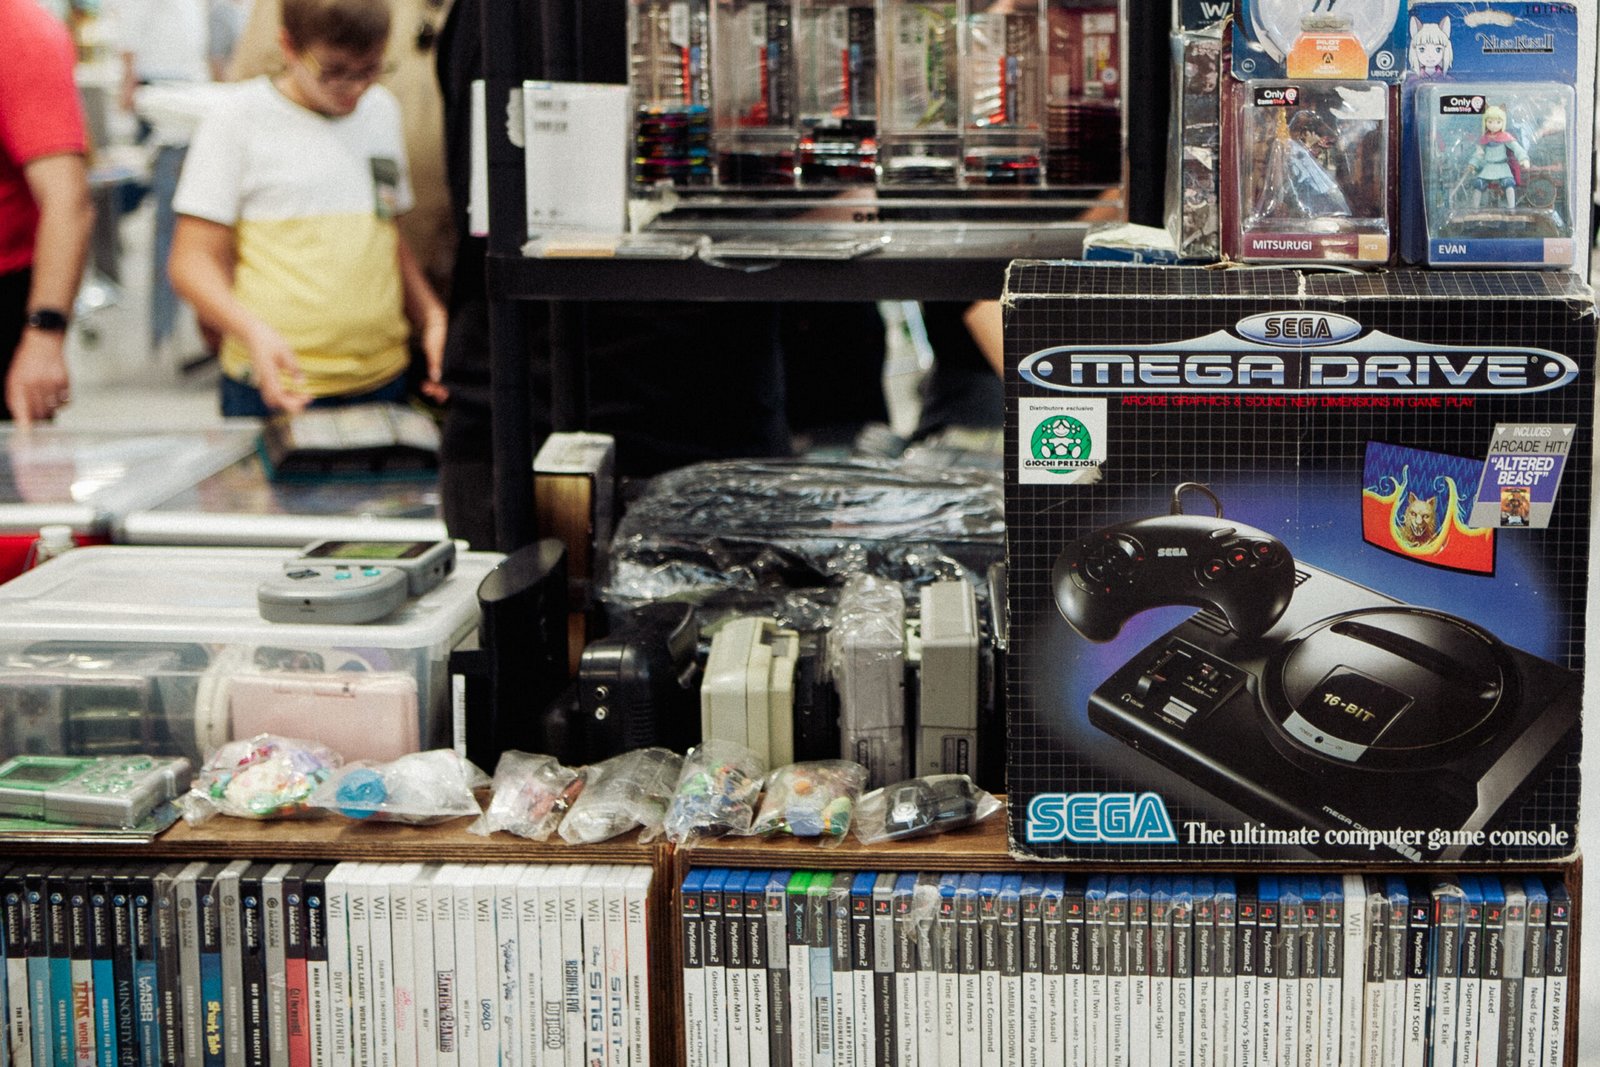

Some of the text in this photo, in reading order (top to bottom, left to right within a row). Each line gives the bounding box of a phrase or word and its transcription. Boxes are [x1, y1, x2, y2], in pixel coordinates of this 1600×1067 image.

[1252, 238, 1313, 251] MITSURUGI
[1438, 243, 1467, 255] EVAN
[1264, 317, 1332, 339] SEGA
[1070, 354, 1284, 385] MEGA
[1122, 395, 1168, 407] ARCADE
[1172, 395, 1231, 407] GRAPHICS
[1233, 396, 1241, 407] &
[1291, 396, 1318, 408] NEW
[1321, 397, 1390, 408] DIMENSIONS
[1392, 398, 1404, 408] IN
[1408, 398, 1442, 408] GAME
[1446, 398, 1475, 408] PLAY
[1513, 427, 1552, 437] INCLUDES
[1491, 440, 1568, 453] ARCADE HIT!
[1157, 547, 1188, 557] SEGA
[1323, 693, 1376, 721] 16-BIT
[1026, 792, 1179, 844] SEGA
[1183, 821, 1569, 850] The ultimate computer game console
[330, 895, 341, 918] Wii
[353, 898, 364, 920] Wii
[374, 897, 385, 919] Wii
[395, 898, 406, 920] Wii
[416, 899, 428, 921] Wii
[437, 897, 449, 920] Wii
[458, 898, 469, 920] Wii
[478, 900, 489, 922] Wii
[501, 897, 513, 920] Wii
[523, 900, 535, 922] Wii
[545, 900, 557, 922] Wii
[566, 899, 578, 921] Wii
[588, 899, 600, 922] Wii
[609, 900, 621, 922] Wii
[629, 900, 641, 923] Wii
[1349, 913, 1361, 936] Wii
[334, 971, 344, 1004] DEWY'S
[565, 960, 580, 1013] RESIDENT EVIL
[1048, 980, 1057, 1008] Sniper
[1263, 982, 1270, 995] We
[1413, 983, 1421, 1012] SILENT
[1442, 982, 1451, 1003] Myst
[1553, 981, 1561, 1003] STAR
[1029, 994, 1037, 1004] of
[1372, 989, 1380, 1017] Shadow
[1530, 987, 1538, 1009] Need
[118, 980, 132, 1042] MINORITY
[1156, 981, 1164, 1039] Second Sight
[1199, 999, 1207, 1029] Legend
[1242, 1001, 1250, 1036] Clancy's
[1529, 1012, 1537, 1024] for
[207, 1001, 221, 1055] Shark Tale
[987, 1007, 995, 1052] Command
[1029, 1007, 1037, 1043] Fighting
[1114, 1015, 1122, 1052] Ultimate
[1285, 1026, 1293, 1041] Hot
[1463, 983, 1474, 1064] Superman Returns
[1008, 1019, 1016, 1059] SHODOWN
[1201, 1032, 1207, 1040] of
